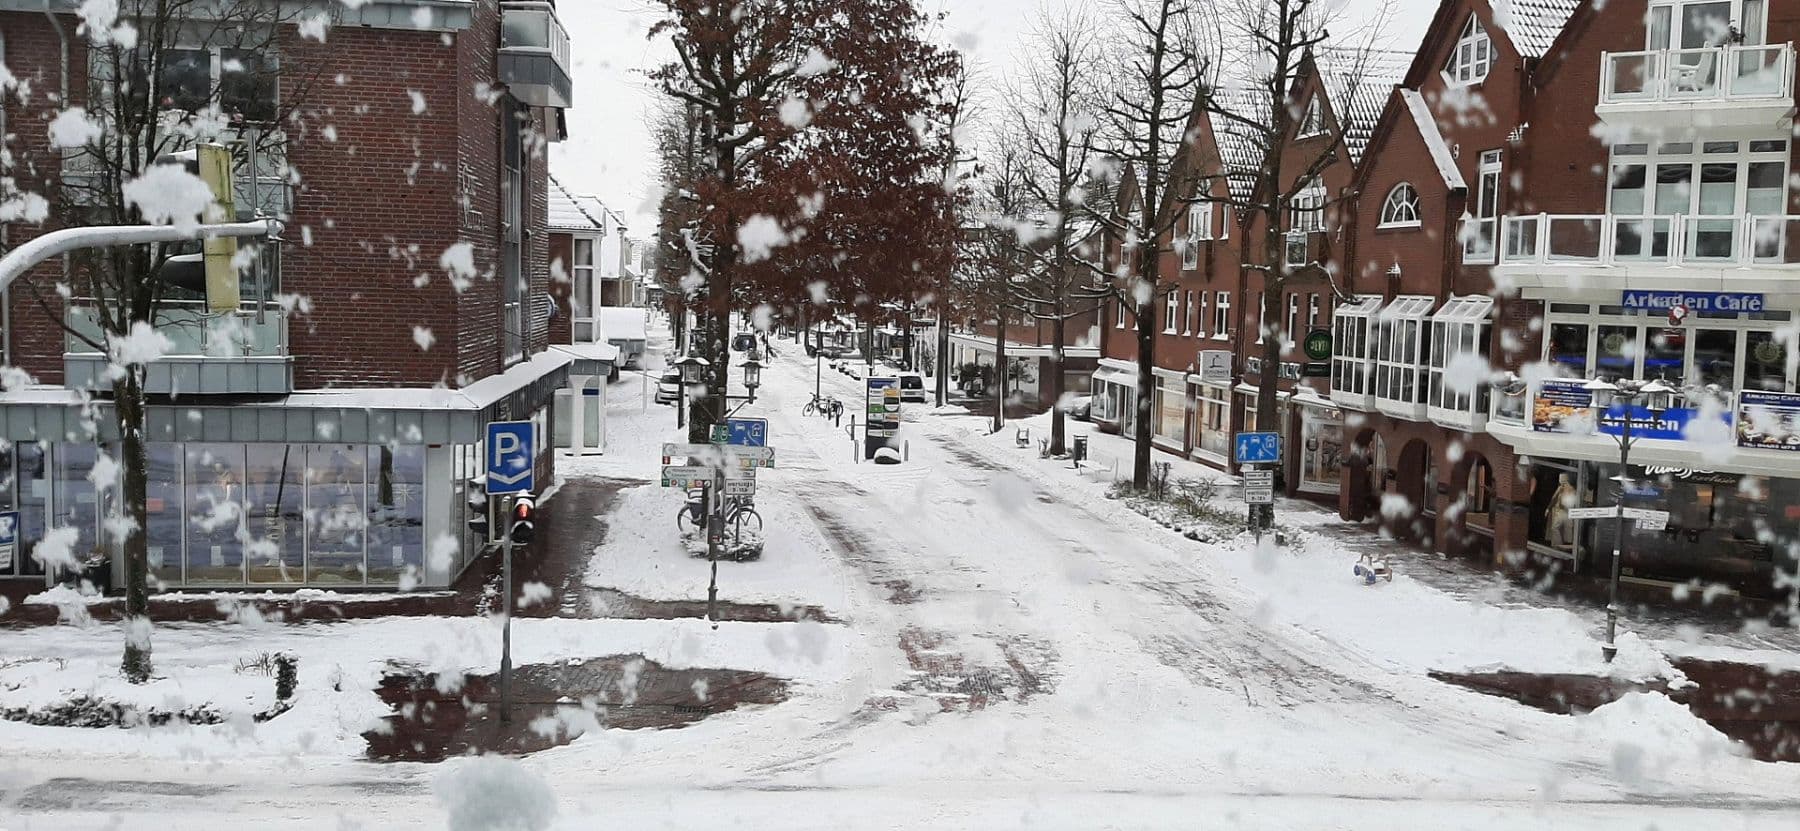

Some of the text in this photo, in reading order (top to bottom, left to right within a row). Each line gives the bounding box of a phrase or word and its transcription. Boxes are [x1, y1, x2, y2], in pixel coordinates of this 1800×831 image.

[1624, 292, 1761, 311] Arkaden Café
[495, 432, 520, 467] P
